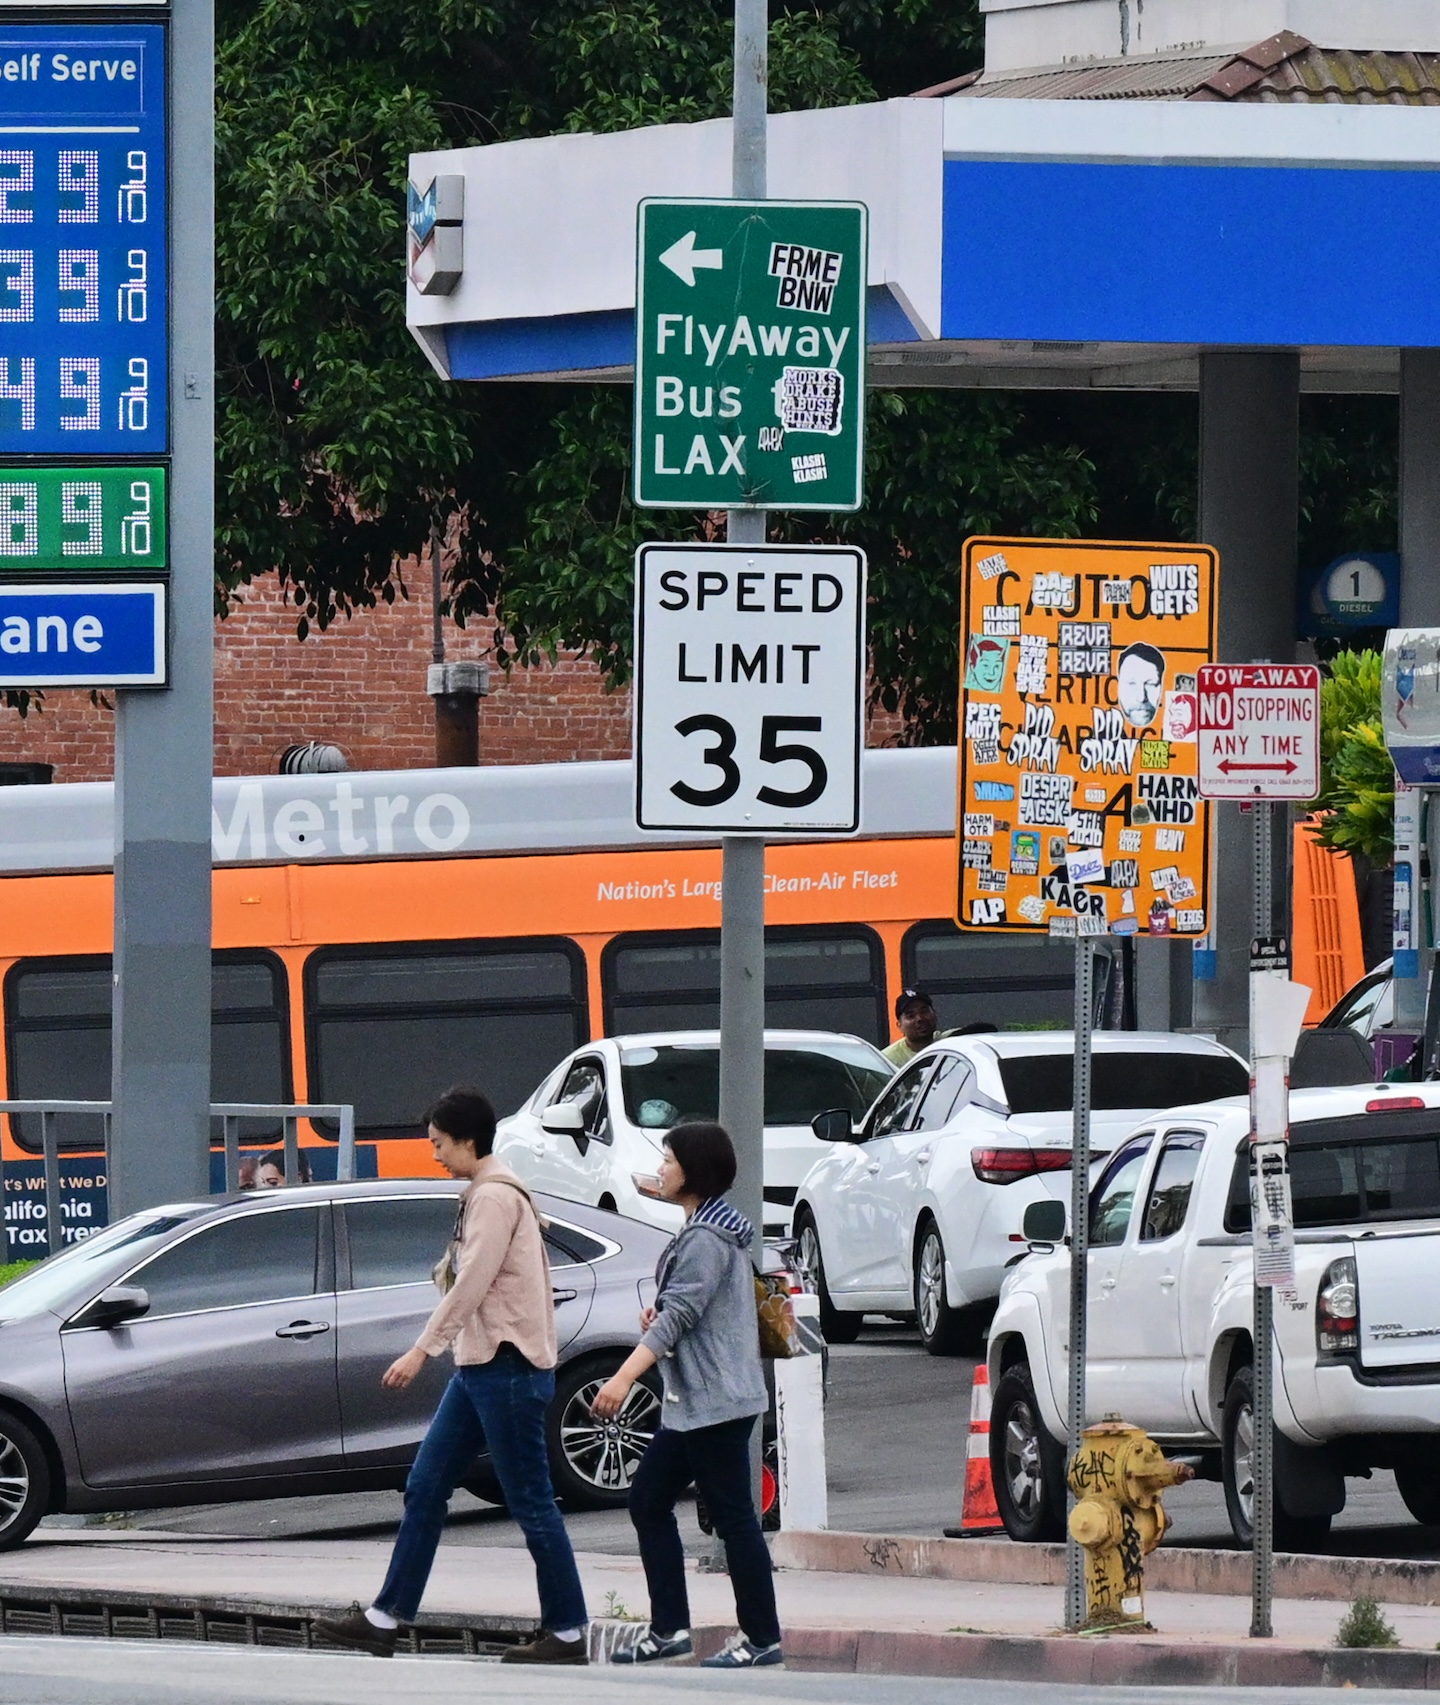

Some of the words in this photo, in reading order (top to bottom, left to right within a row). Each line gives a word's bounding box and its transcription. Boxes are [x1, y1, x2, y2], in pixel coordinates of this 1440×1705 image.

[51, 54, 137, 82] Serve
[771, 245, 840, 284] FRME
[778, 277, 833, 313] BNW
[657, 314, 851, 369] FlyAway
[656, 376, 742, 418] Bus
[785, 383, 837, 398] DRAKE
[785, 409, 833, 425] HINTS
[786, 397, 834, 412] ABUSE
[654, 434, 747, 475] LAX
[1148, 564, 1198, 590] WUTS
[1350, 570, 1360, 597] 1
[659, 570, 843, 613] SPEED
[1150, 589, 1199, 615] GETS
[1339, 604, 1374, 613] DIESEL
[678, 642, 821, 684] LIMIT
[1201, 668, 1313, 686] TOW-AWAY
[966, 702, 1001, 721] PEC
[1200, 692, 1231, 727] NO
[1237, 698, 1313, 721] STOPPING
[965, 720, 1000, 740] MOTA
[1006, 732, 1061, 773] SPRAY
[1080, 738, 1139, 775] SPRAY
[1213, 736, 1250, 756] ANY
[1261, 736, 1303, 756] TIME
[669, 713, 828, 808] 35
[211, 782, 471, 862] Metro
[965, 815, 992, 825] HARM
[1147, 799, 1194, 824] NHD
[969, 825, 989, 836] OTR
[597, 879, 676, 901] Nation's
[682, 878, 723, 900] Larg
[851, 869, 899, 889] Fleet
[971, 897, 1006, 925] AP
[4, 1177, 22, 1192] t's
[68, 1176, 93, 1189] We
[6, 1226, 47, 1245] Tax
[1368, 1323, 1403, 1331] TOYOTA
